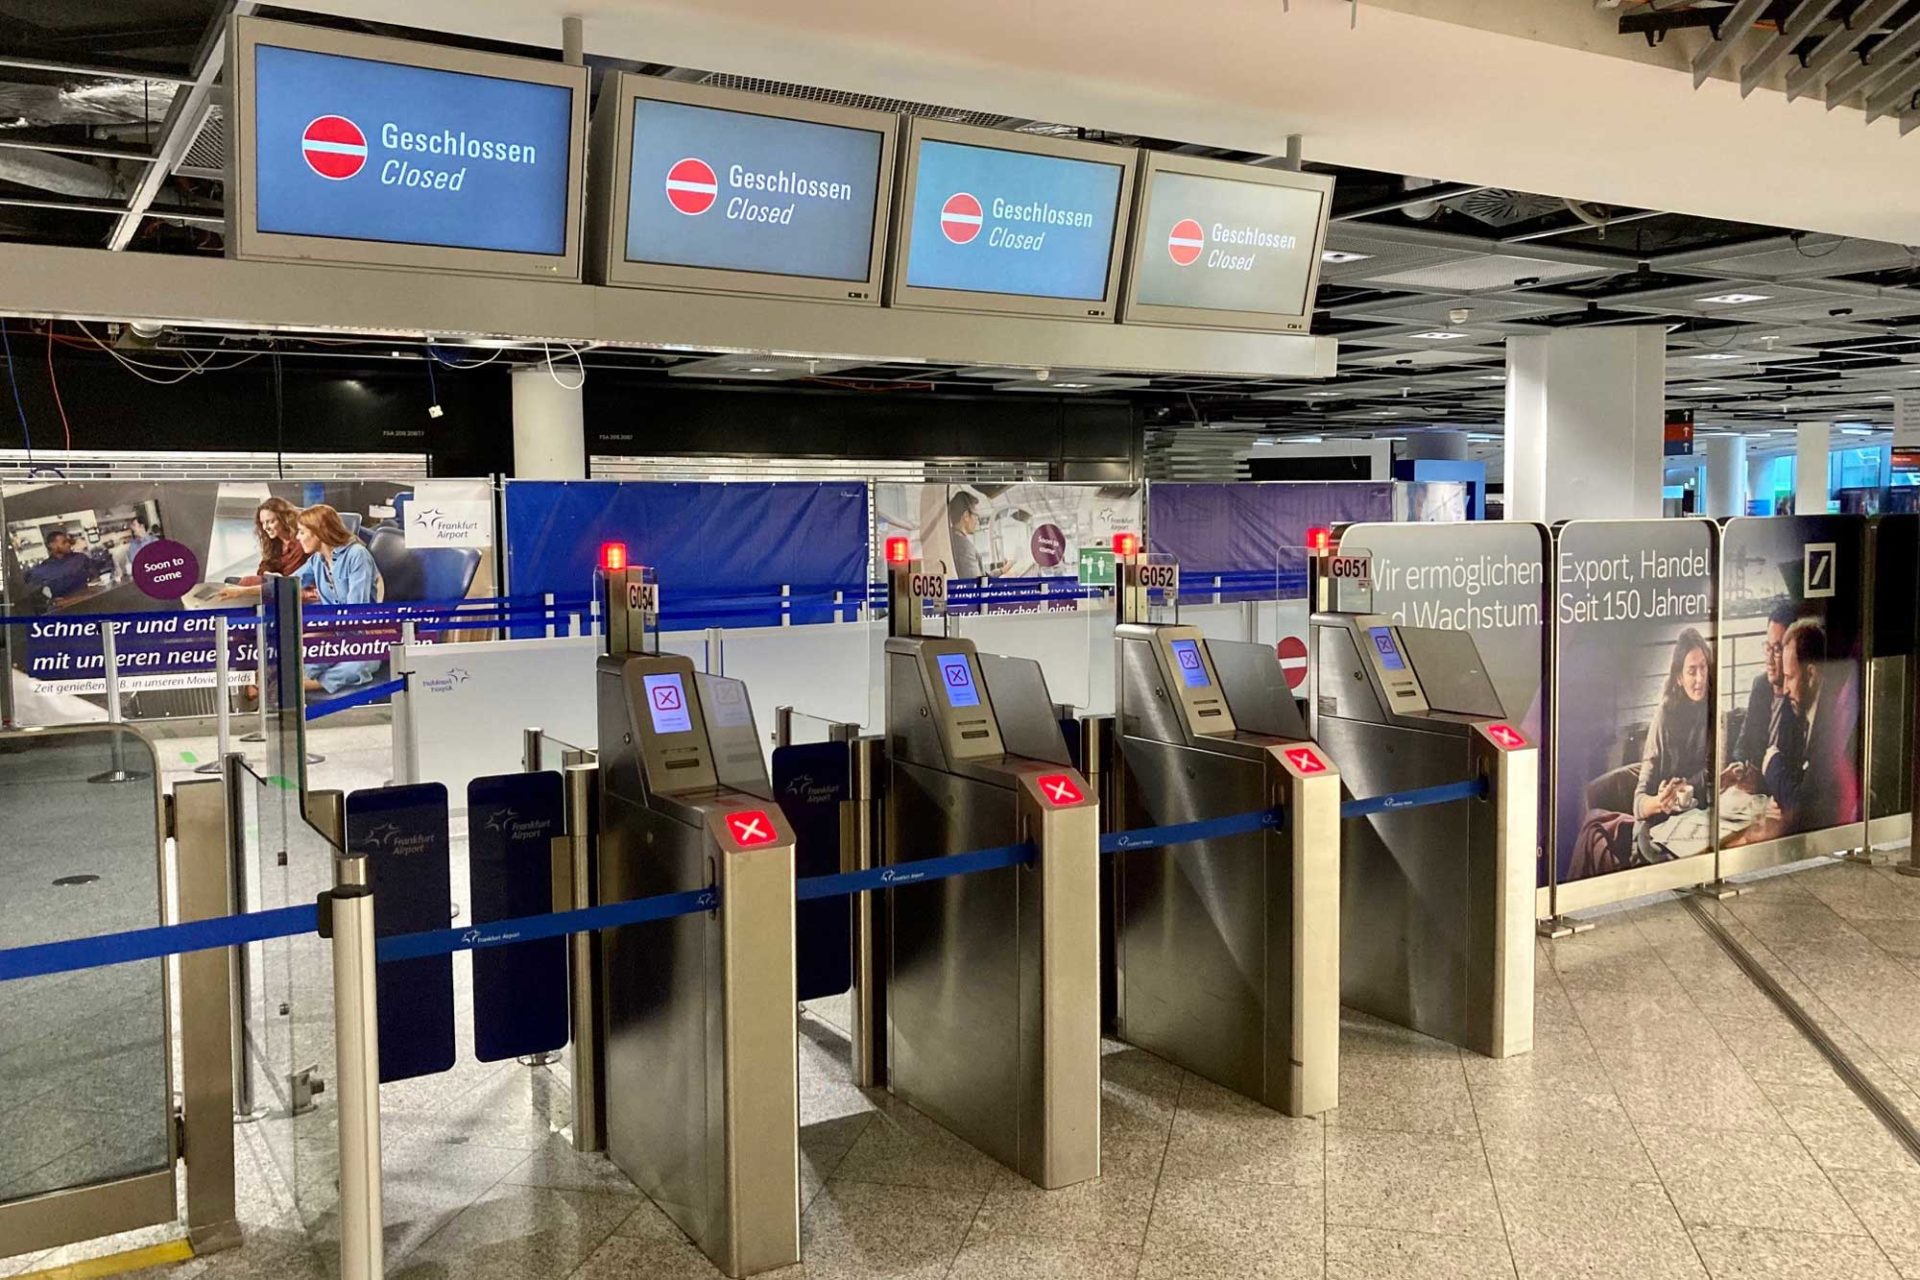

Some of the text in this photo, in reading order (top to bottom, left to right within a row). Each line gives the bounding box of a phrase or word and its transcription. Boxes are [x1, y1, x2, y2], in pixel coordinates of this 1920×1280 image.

[381, 123, 536, 164] Geschlossen
[380, 159, 466, 191] Closed
[729, 164, 852, 200] Geschlossen
[726, 197, 795, 225] Closed
[992, 197, 1093, 228] Geschlossen
[989, 227, 1046, 251] Closed
[1212, 223, 1297, 249] Geschlossen
[1207, 249, 1256, 271] Closed
[436, 529, 469, 541] Airport
[437, 520, 479, 532] Frankfurt
[144, 557, 184, 573] Soon to
[1332, 558, 1367, 578] G051
[1405, 554, 1543, 596] ermöglichen
[1560, 552, 1634, 589] Export,
[1640, 548, 1711, 579] Handel
[153, 570, 182, 584] come
[912, 574, 943, 598] G053
[1140, 566, 1174, 587] G052
[629, 584, 654, 611] G054
[1413, 598, 1544, 631] Wachstum.
[1560, 592, 1599, 624] Seit
[1603, 589, 1641, 621] 150
[1644, 587, 1711, 618] Jahren.
[31, 621, 130, 638] Schneer
[136, 617, 177, 634] und
[33, 657, 69, 670] mit
[76, 651, 160, 668] uneren
[33, 683, 53, 694] Zeit
[55, 681, 105, 697] genießen
[144, 677, 184, 688] unseren
[226, 673, 251, 684] orlds
[511, 829, 541, 841] Airport
[512, 819, 551, 831] Frankfurt
[392, 844, 424, 856] Airport
[394, 833, 434, 845] Frankfurt
